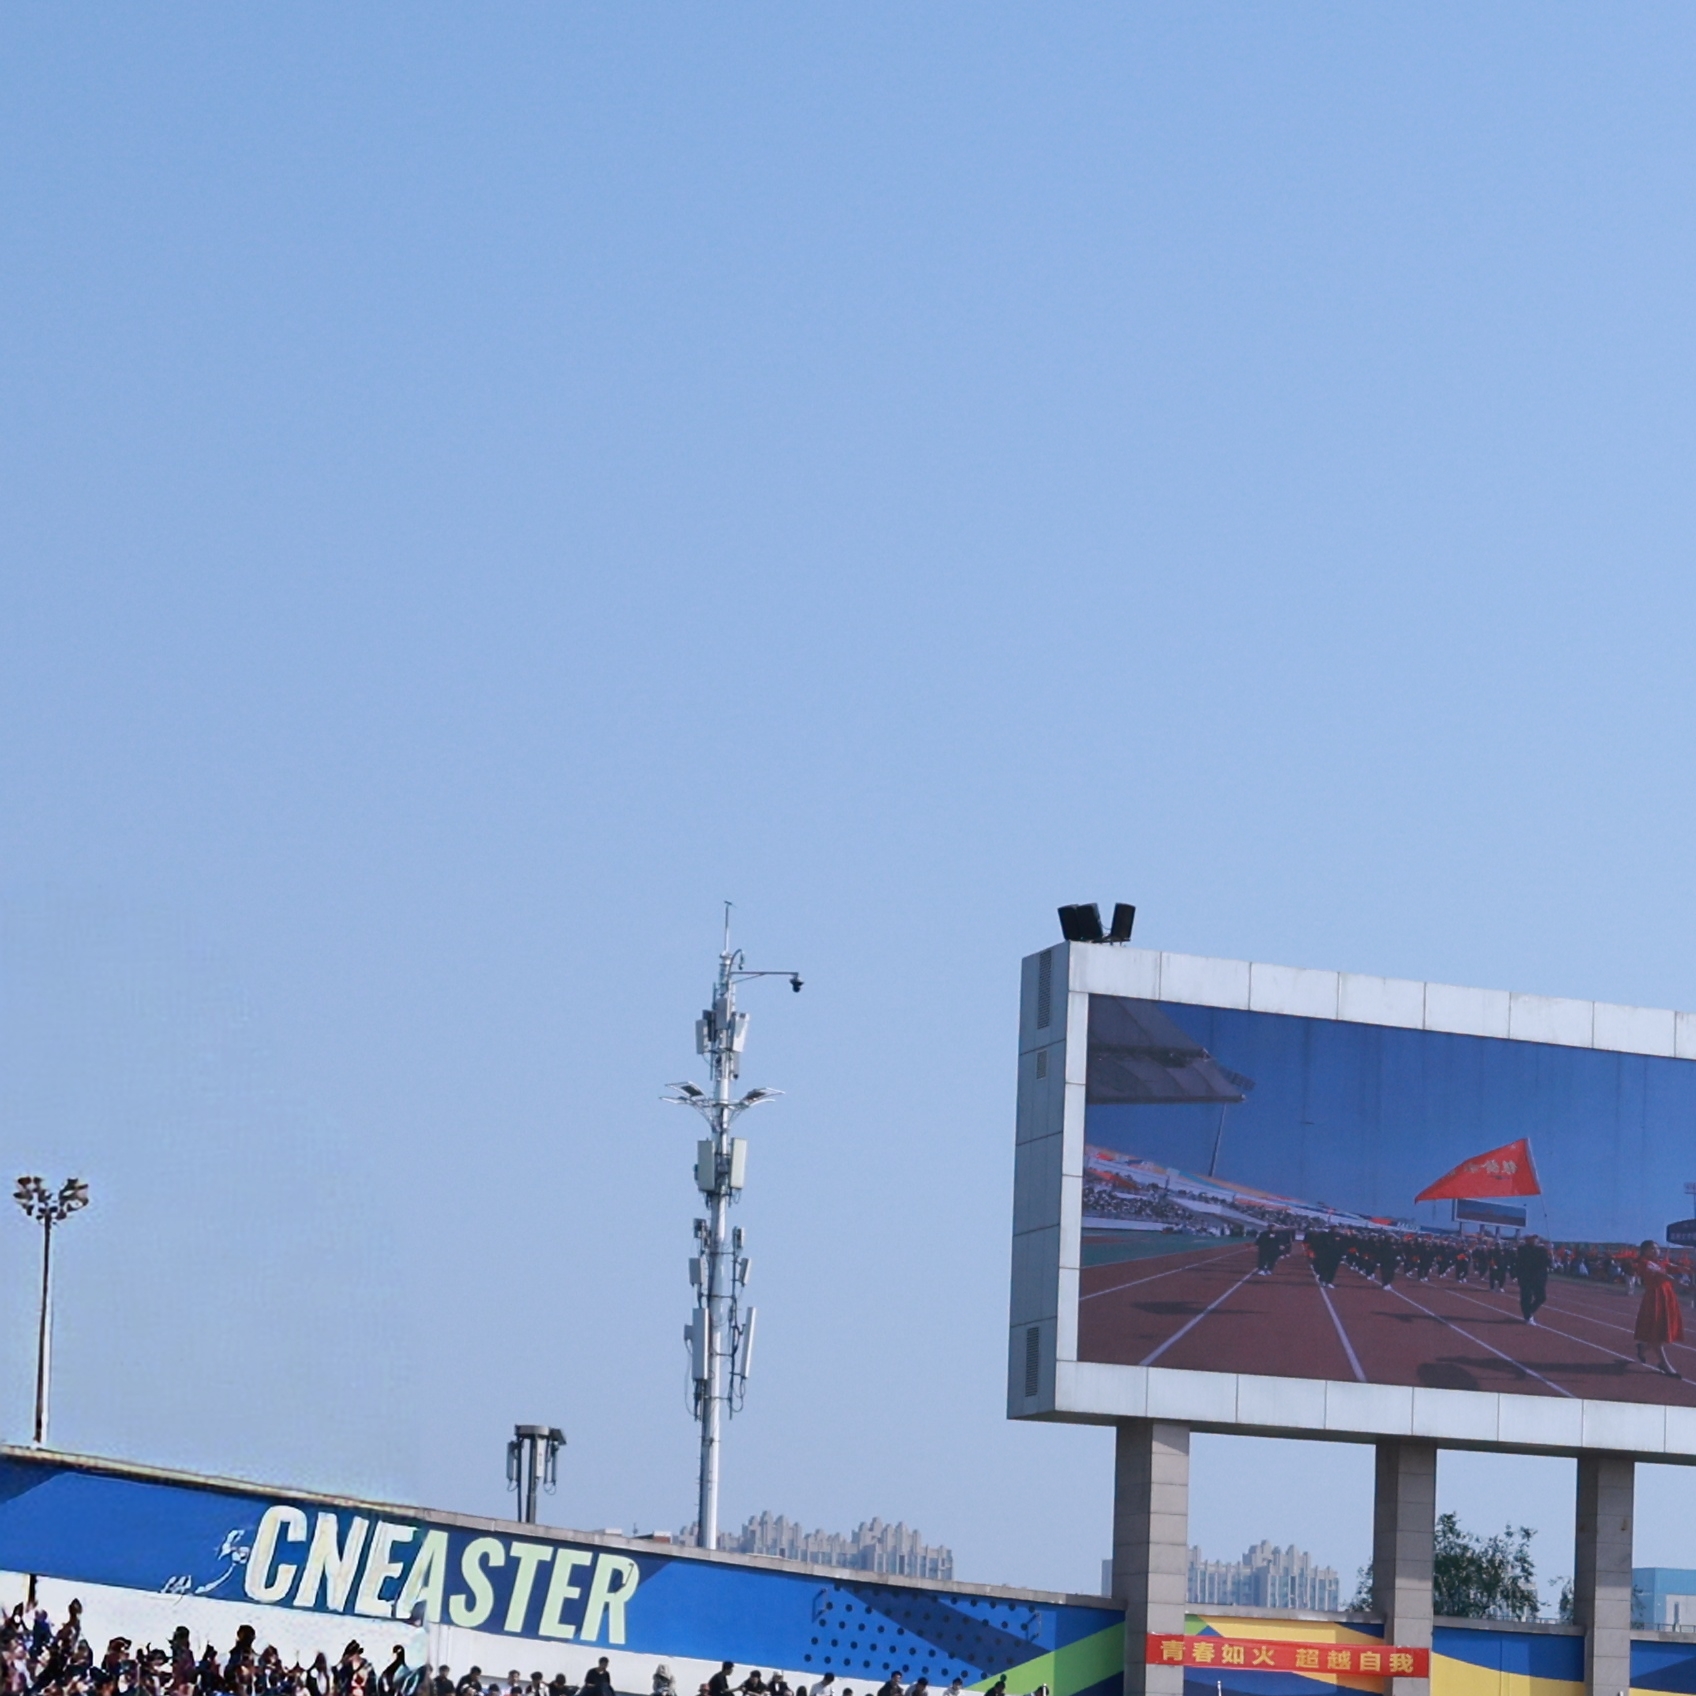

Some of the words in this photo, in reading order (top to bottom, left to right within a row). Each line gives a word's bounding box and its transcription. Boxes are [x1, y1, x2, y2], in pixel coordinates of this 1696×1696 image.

[1160, 1639, 1275, 1666] 青春如火
[1296, 1648, 1414, 1673] 超越自我
